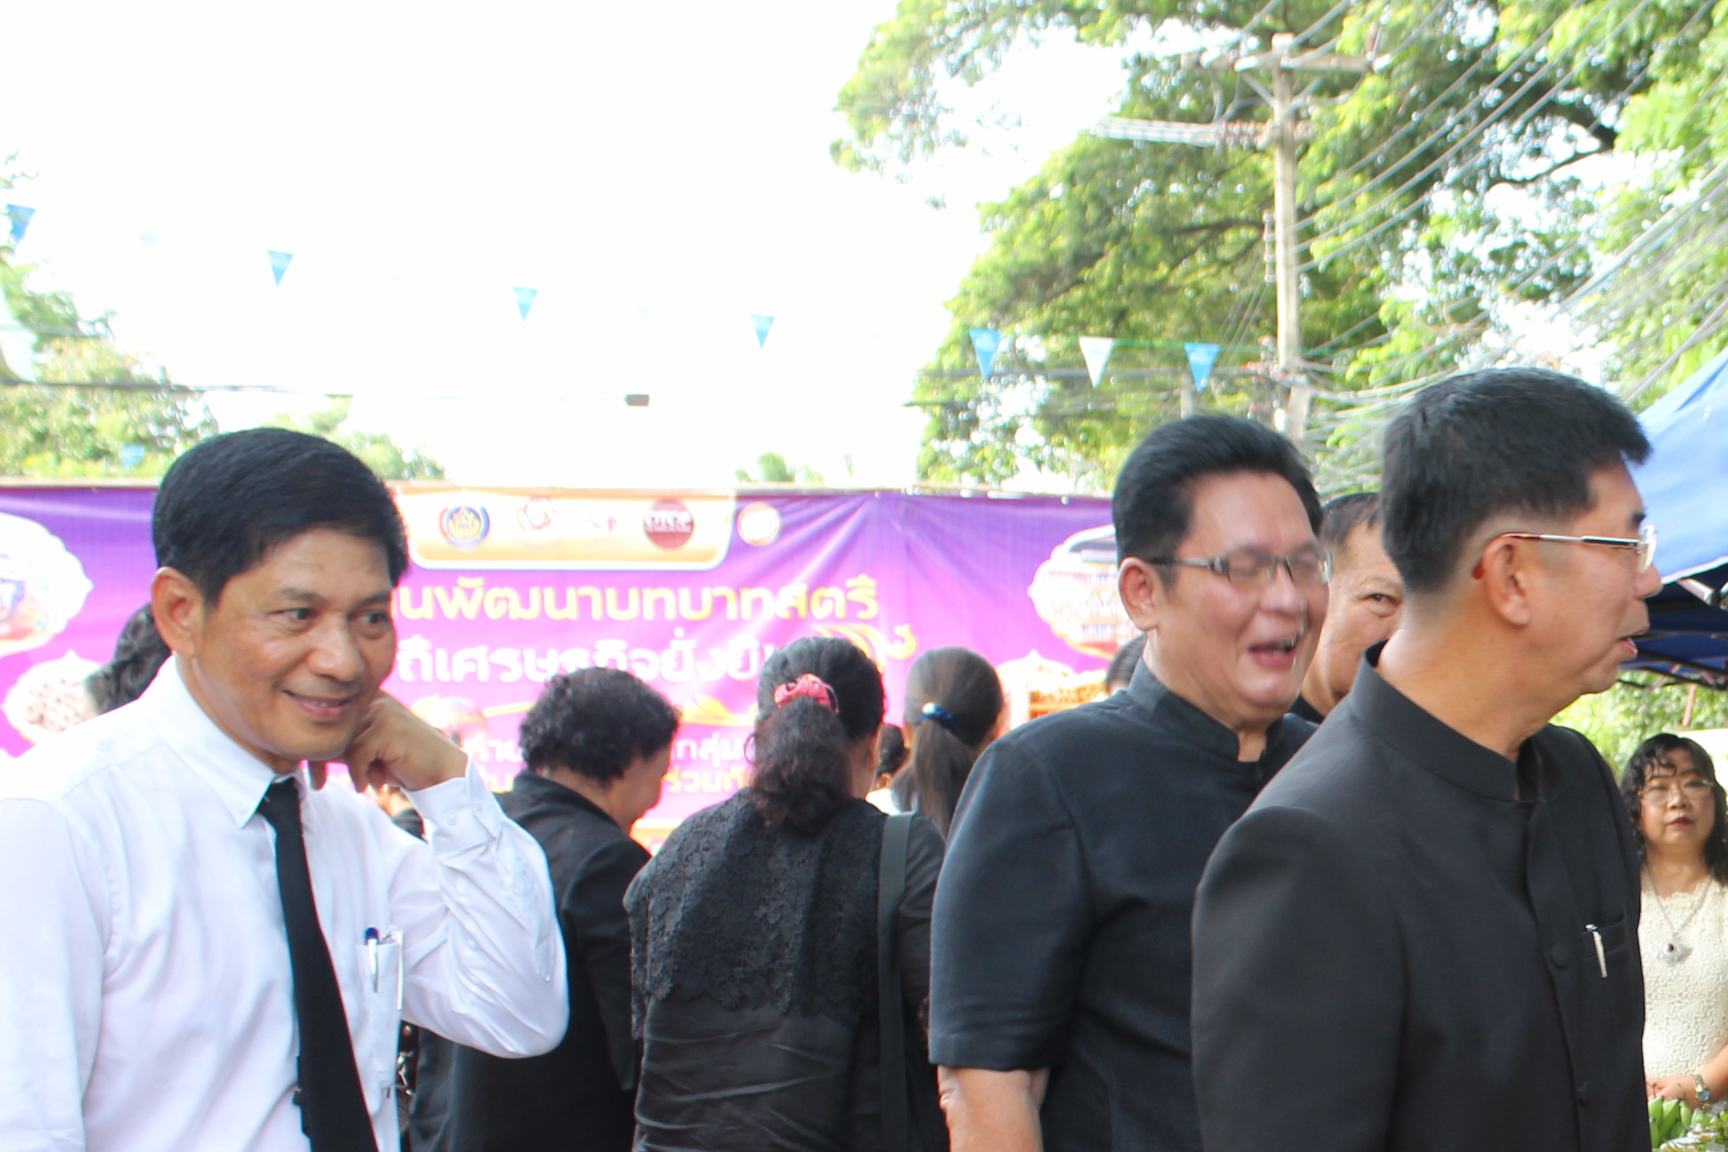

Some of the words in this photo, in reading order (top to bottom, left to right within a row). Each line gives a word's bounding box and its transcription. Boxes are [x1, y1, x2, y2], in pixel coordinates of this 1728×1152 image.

[393, 574, 879, 621] นพัฒนาบทบาทสตรี
